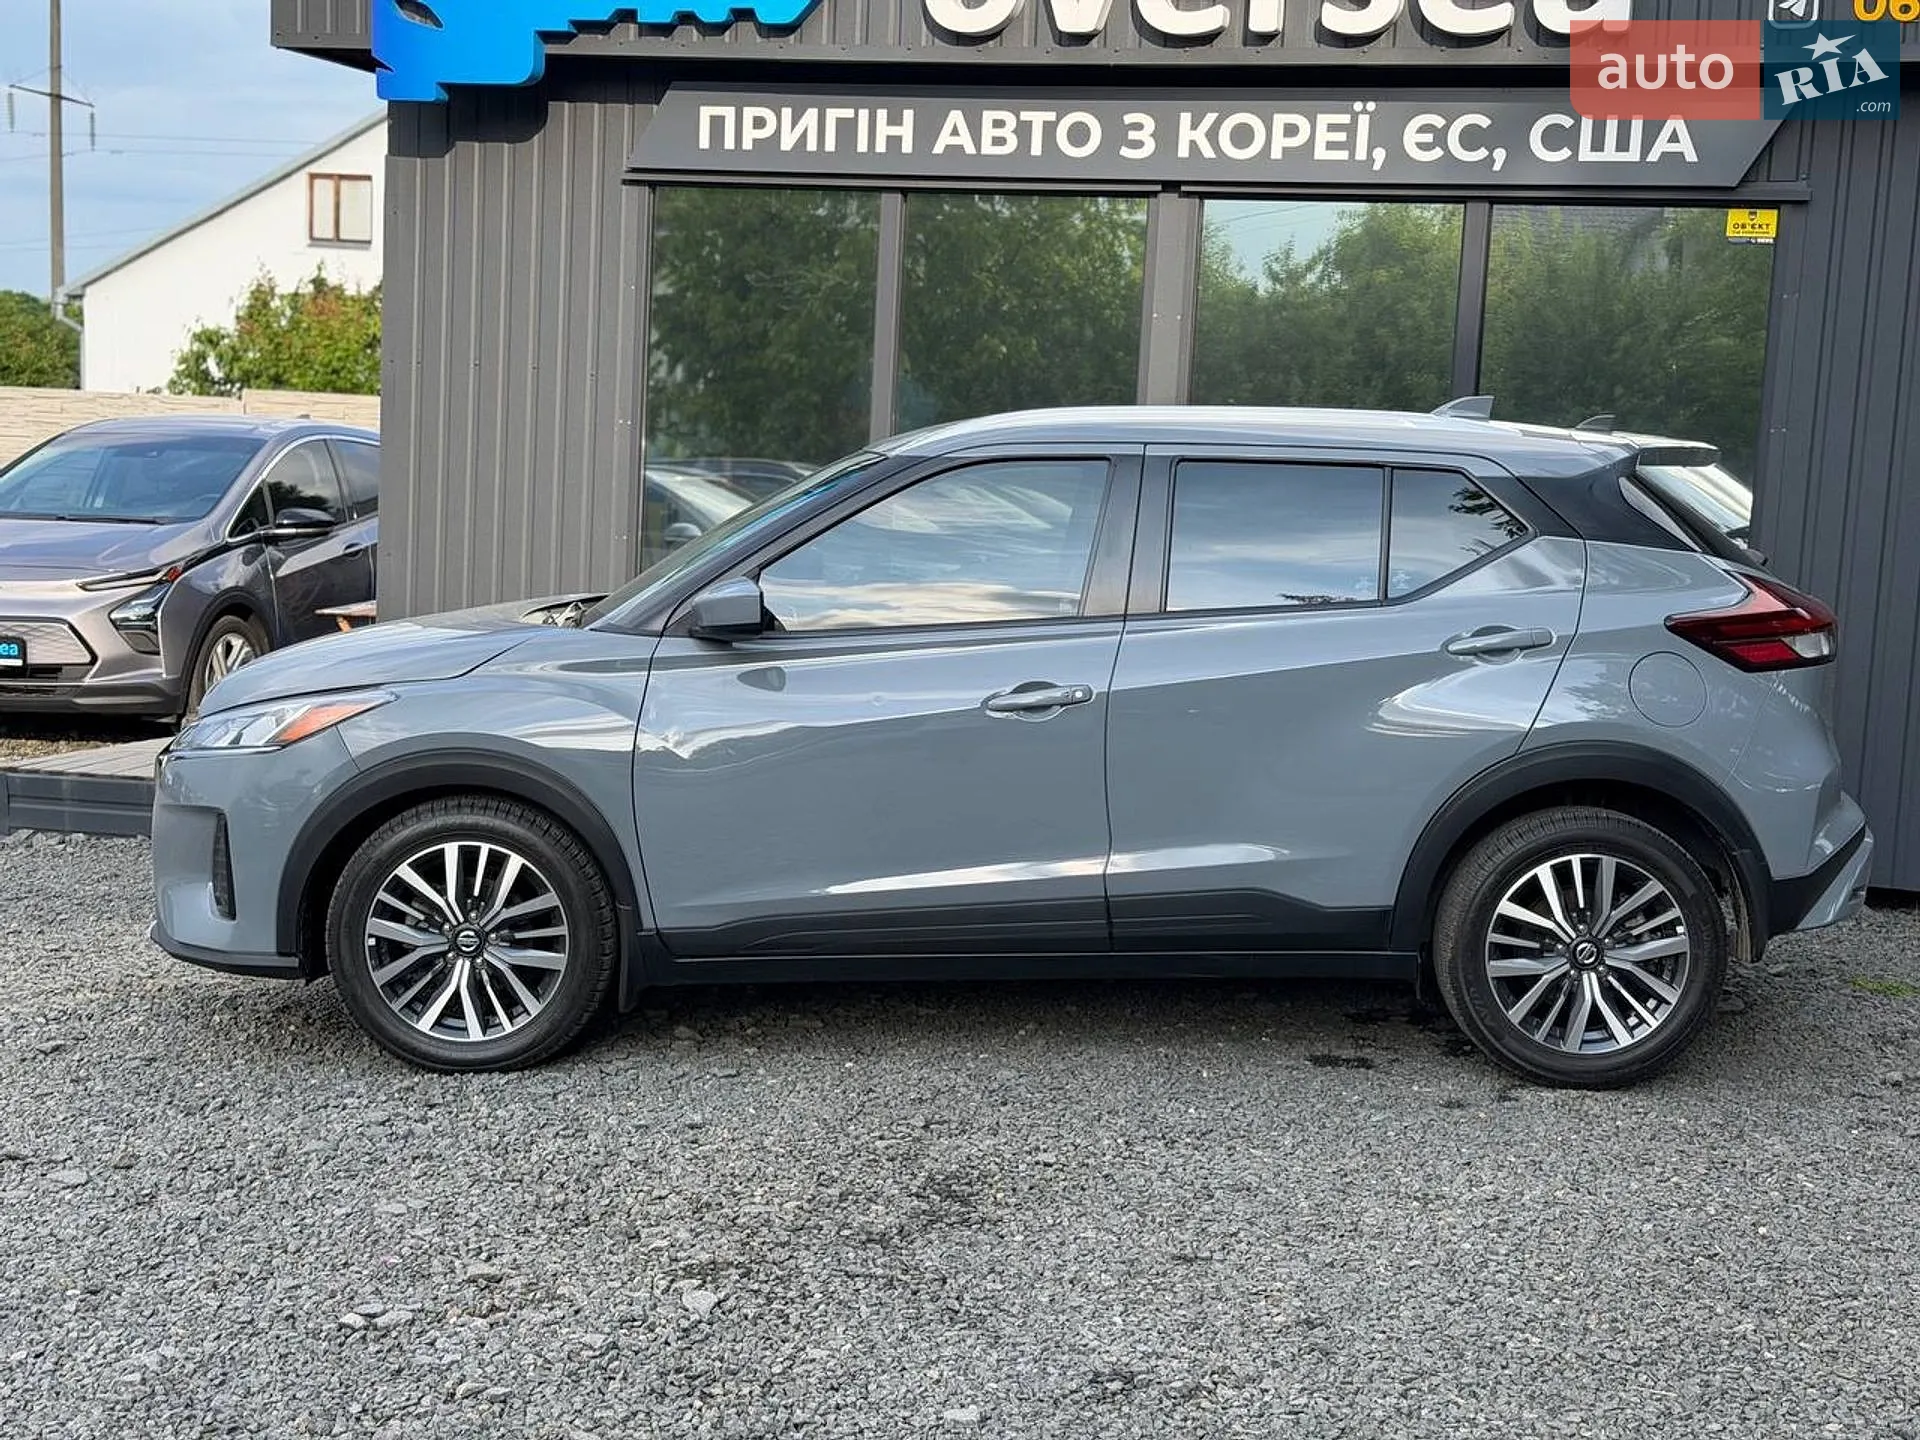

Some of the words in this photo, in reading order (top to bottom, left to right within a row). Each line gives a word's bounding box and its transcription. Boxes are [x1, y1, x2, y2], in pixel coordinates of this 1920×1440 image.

[698, 105, 915, 154] ПРИГІН
[931, 109, 1103, 159] АВТО
[1118, 112, 1157, 160] З
[1177, 101, 1387, 171] КОРЕЇ,
[1402, 113, 1508, 172] ЄС,
[1528, 113, 1699, 163] США
